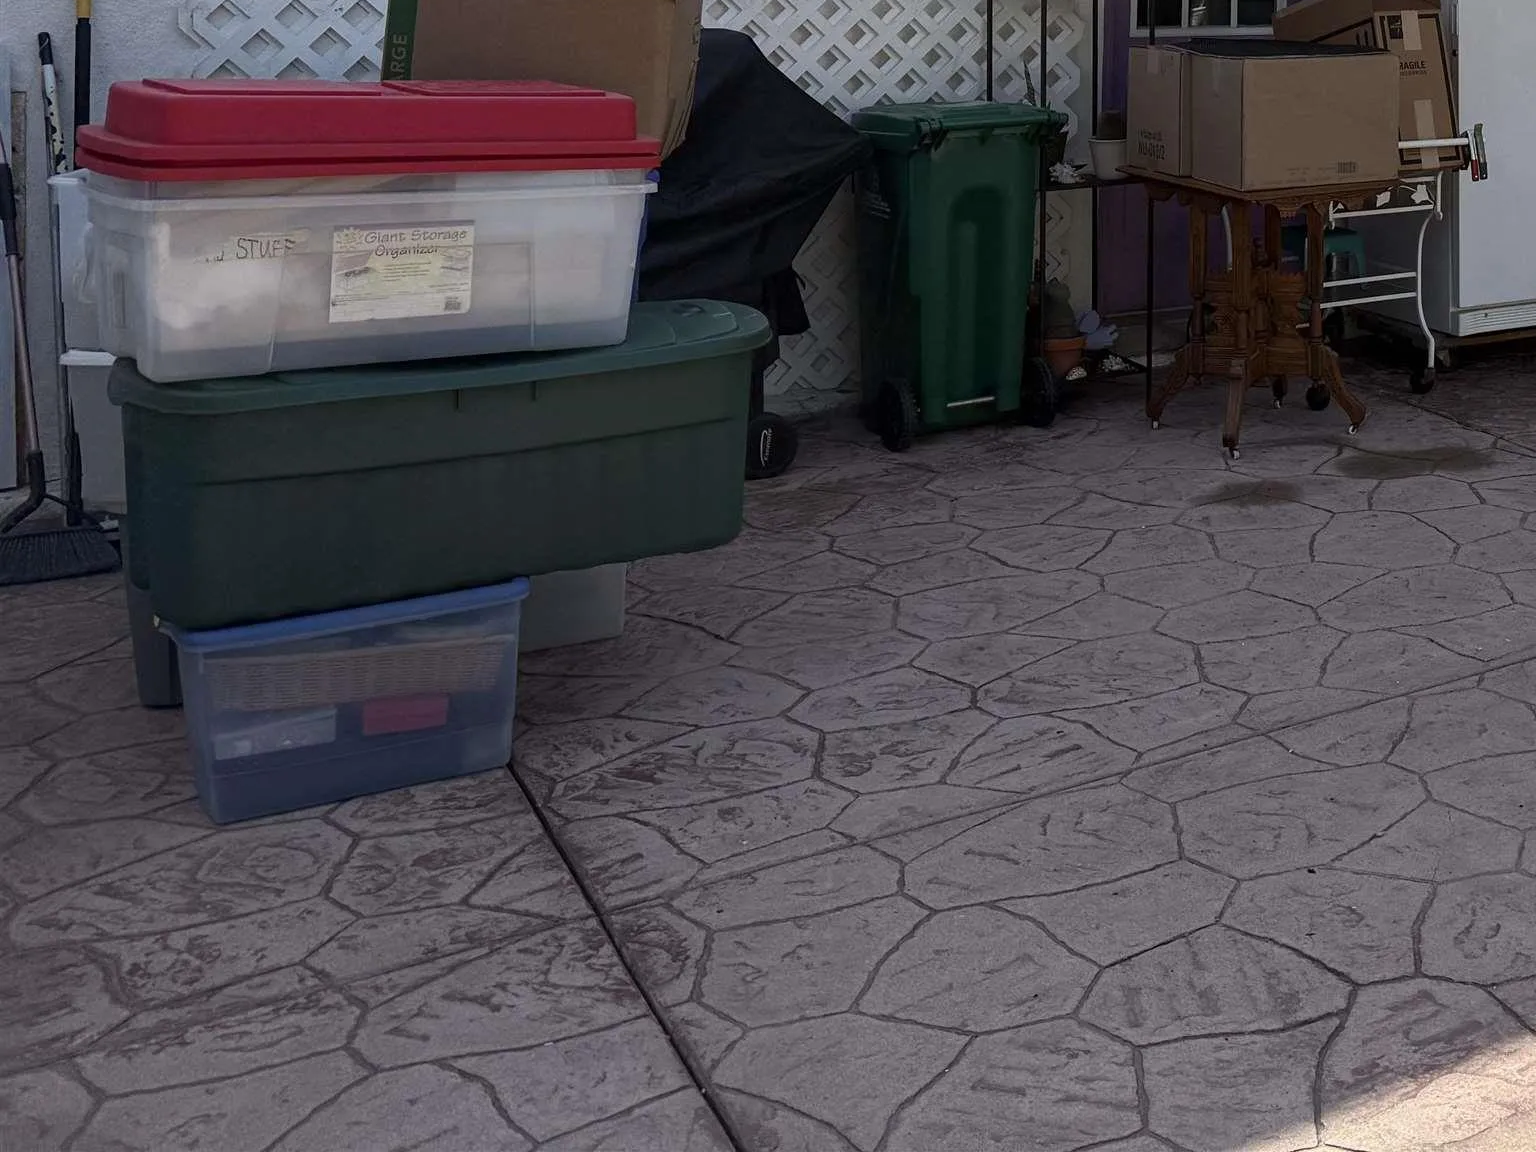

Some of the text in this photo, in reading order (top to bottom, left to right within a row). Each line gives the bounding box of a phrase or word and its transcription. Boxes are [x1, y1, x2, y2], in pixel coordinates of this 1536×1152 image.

[1399, 61, 1427, 70] RAGILE
[364, 229, 468, 244] Giant Storage
